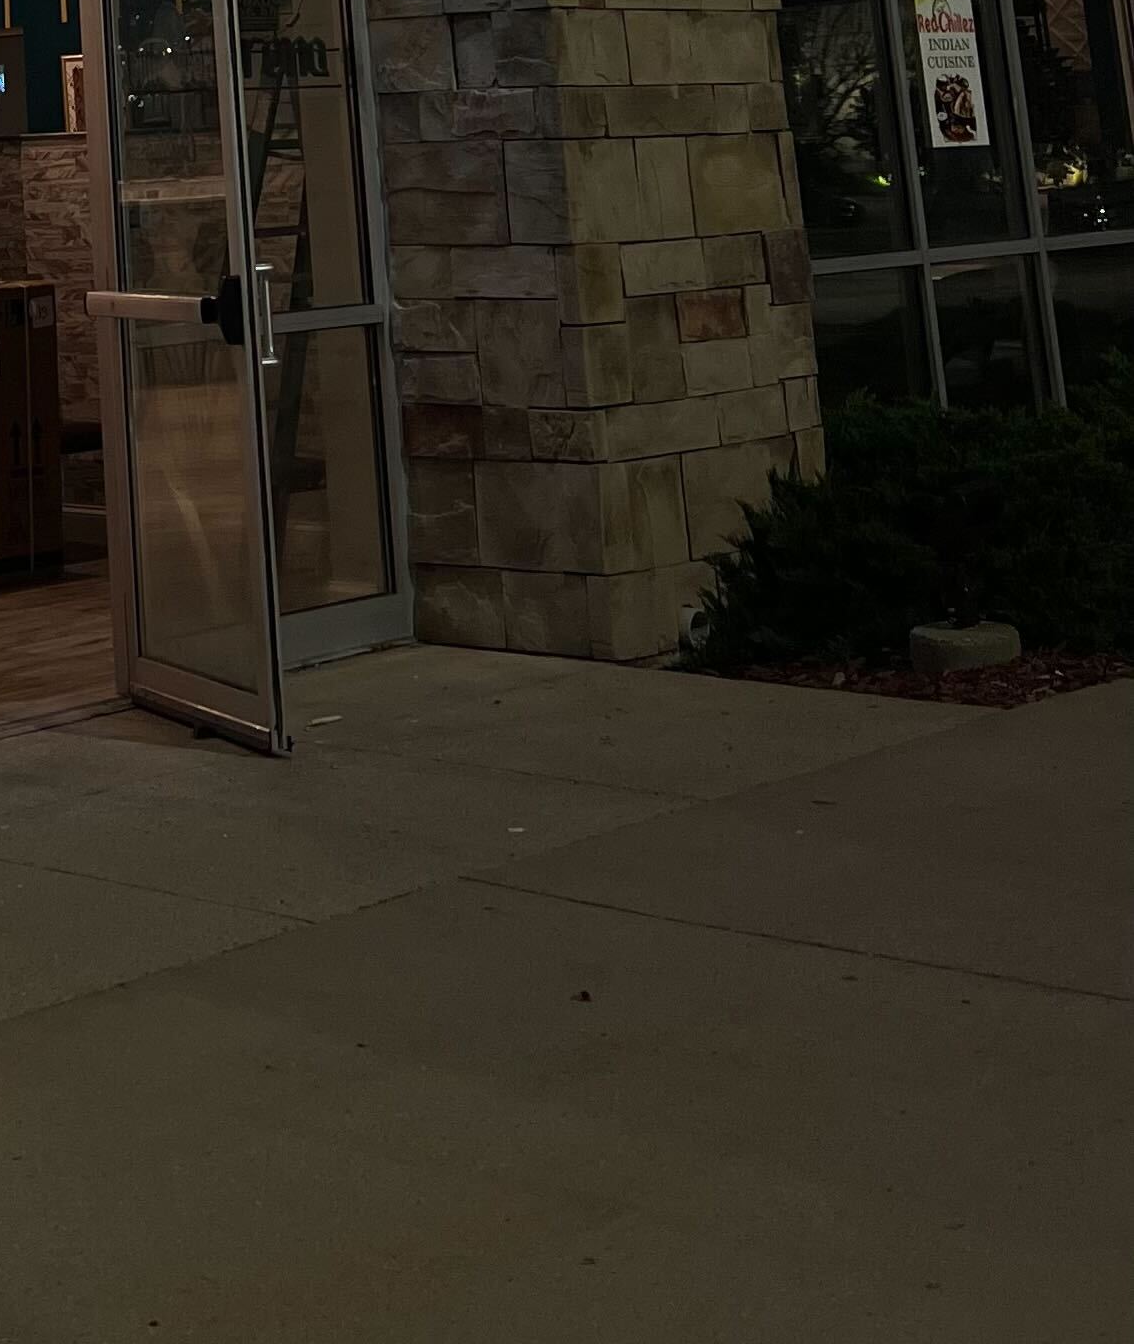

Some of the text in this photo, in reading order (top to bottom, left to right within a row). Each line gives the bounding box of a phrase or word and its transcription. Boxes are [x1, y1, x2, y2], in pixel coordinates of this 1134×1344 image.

[919, 14, 938, 33] Red
[928, 38, 970, 52] INDIAN
[927, 56, 975, 69] CUISINE
